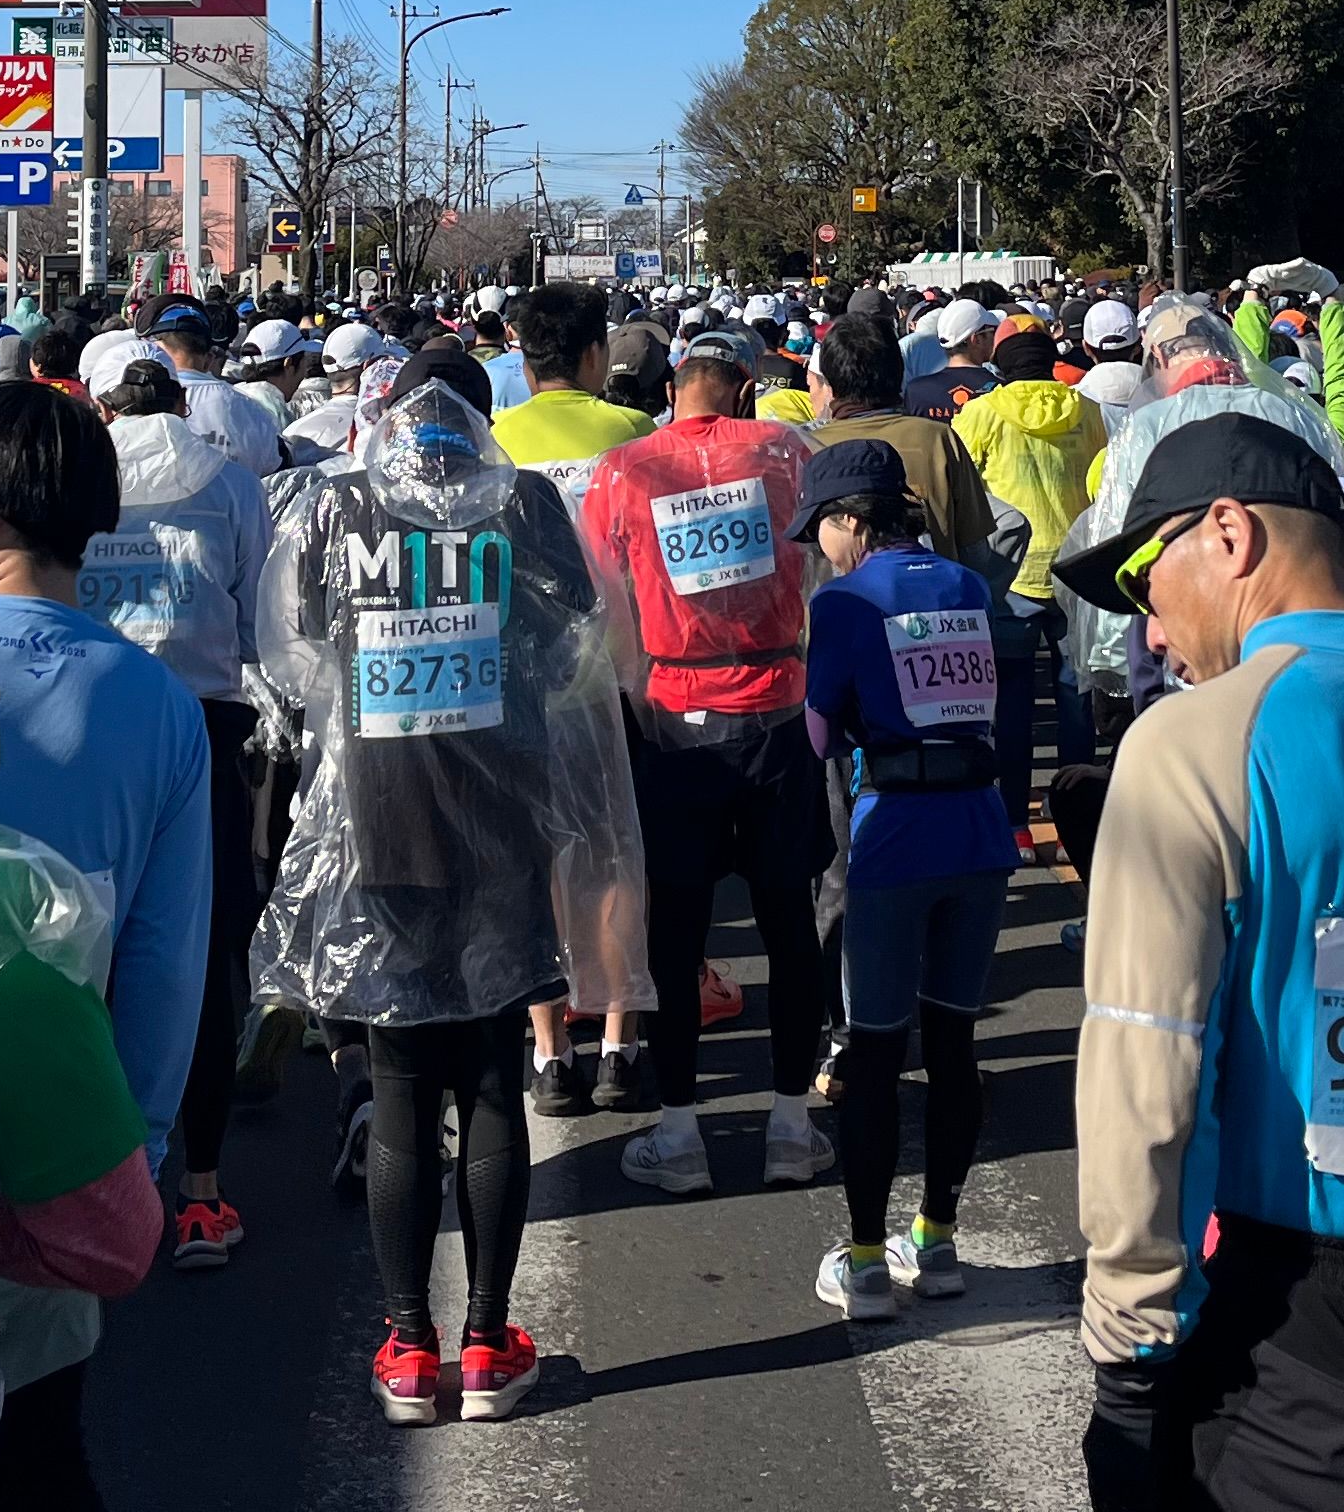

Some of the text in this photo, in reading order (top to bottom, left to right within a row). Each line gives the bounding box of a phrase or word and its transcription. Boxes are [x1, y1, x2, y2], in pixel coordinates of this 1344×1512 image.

[25, 137, 45, 148] Do
[19, 161, 48, 195] P
[670, 487, 748, 516] HITACHI
[665, 519, 769, 563] 8269G
[380, 614, 478, 638] HITACHI
[366, 653, 497, 697] 8273G
[903, 650, 995, 690] 12438G
[940, 703, 986, 717] HITACHI
